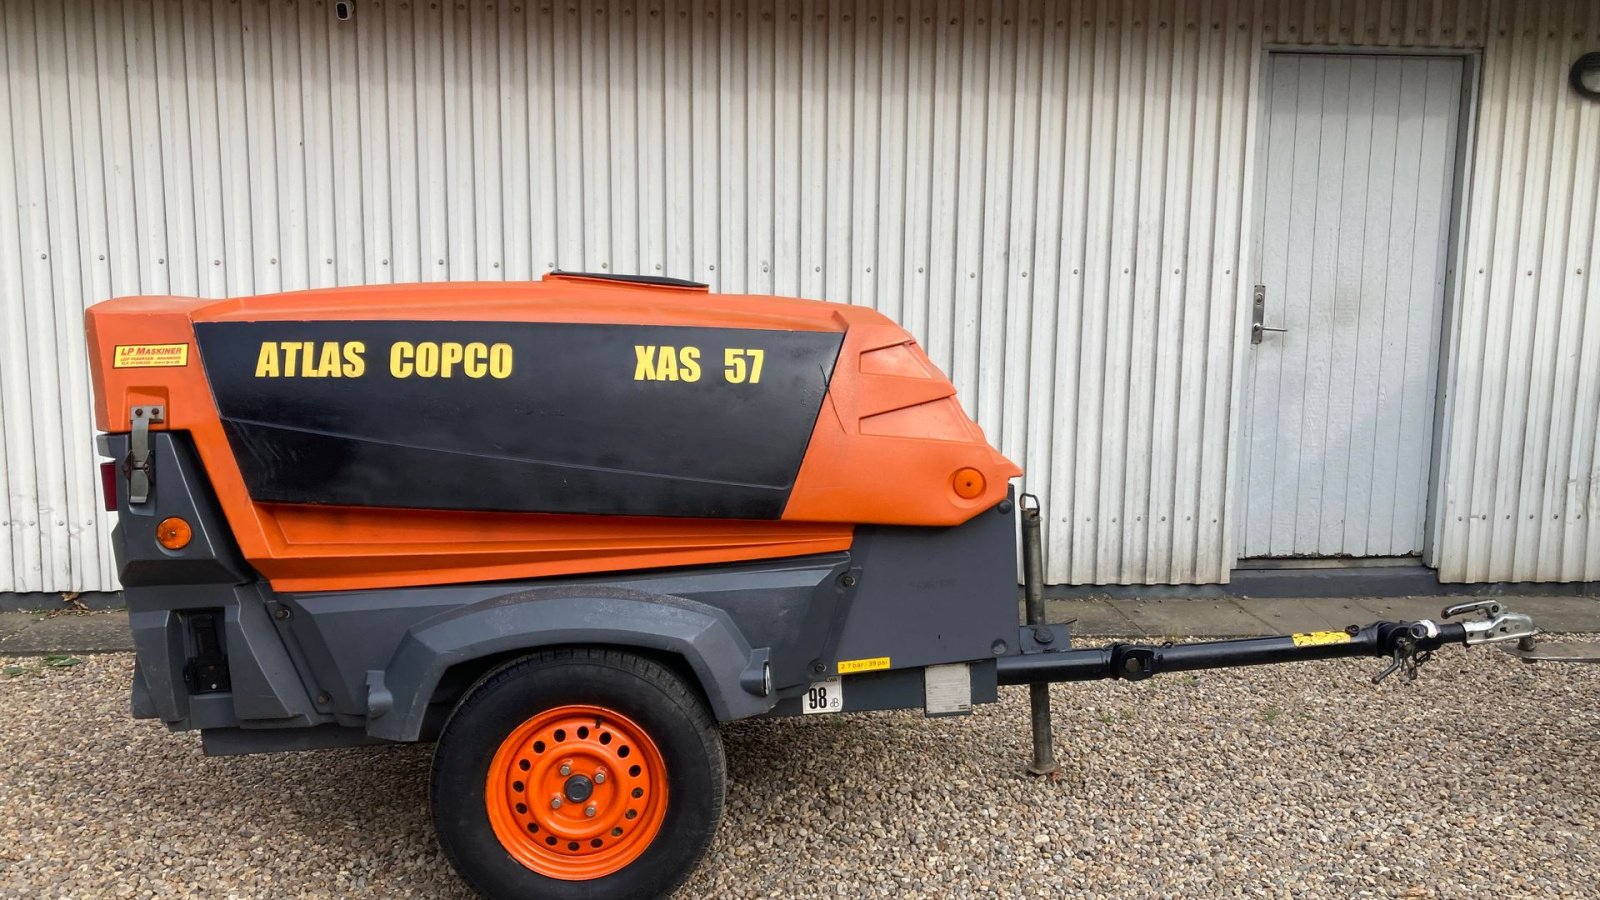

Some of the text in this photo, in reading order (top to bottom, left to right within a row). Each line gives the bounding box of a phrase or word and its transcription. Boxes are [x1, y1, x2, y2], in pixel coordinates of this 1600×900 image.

[121, 347, 182, 356] LP MASKINER
[255, 341, 513, 378] ATLAS COPCO
[634, 345, 764, 384] XAS 57
[877, 660, 888, 668] psi
[808, 687, 839, 709] 98 dB
